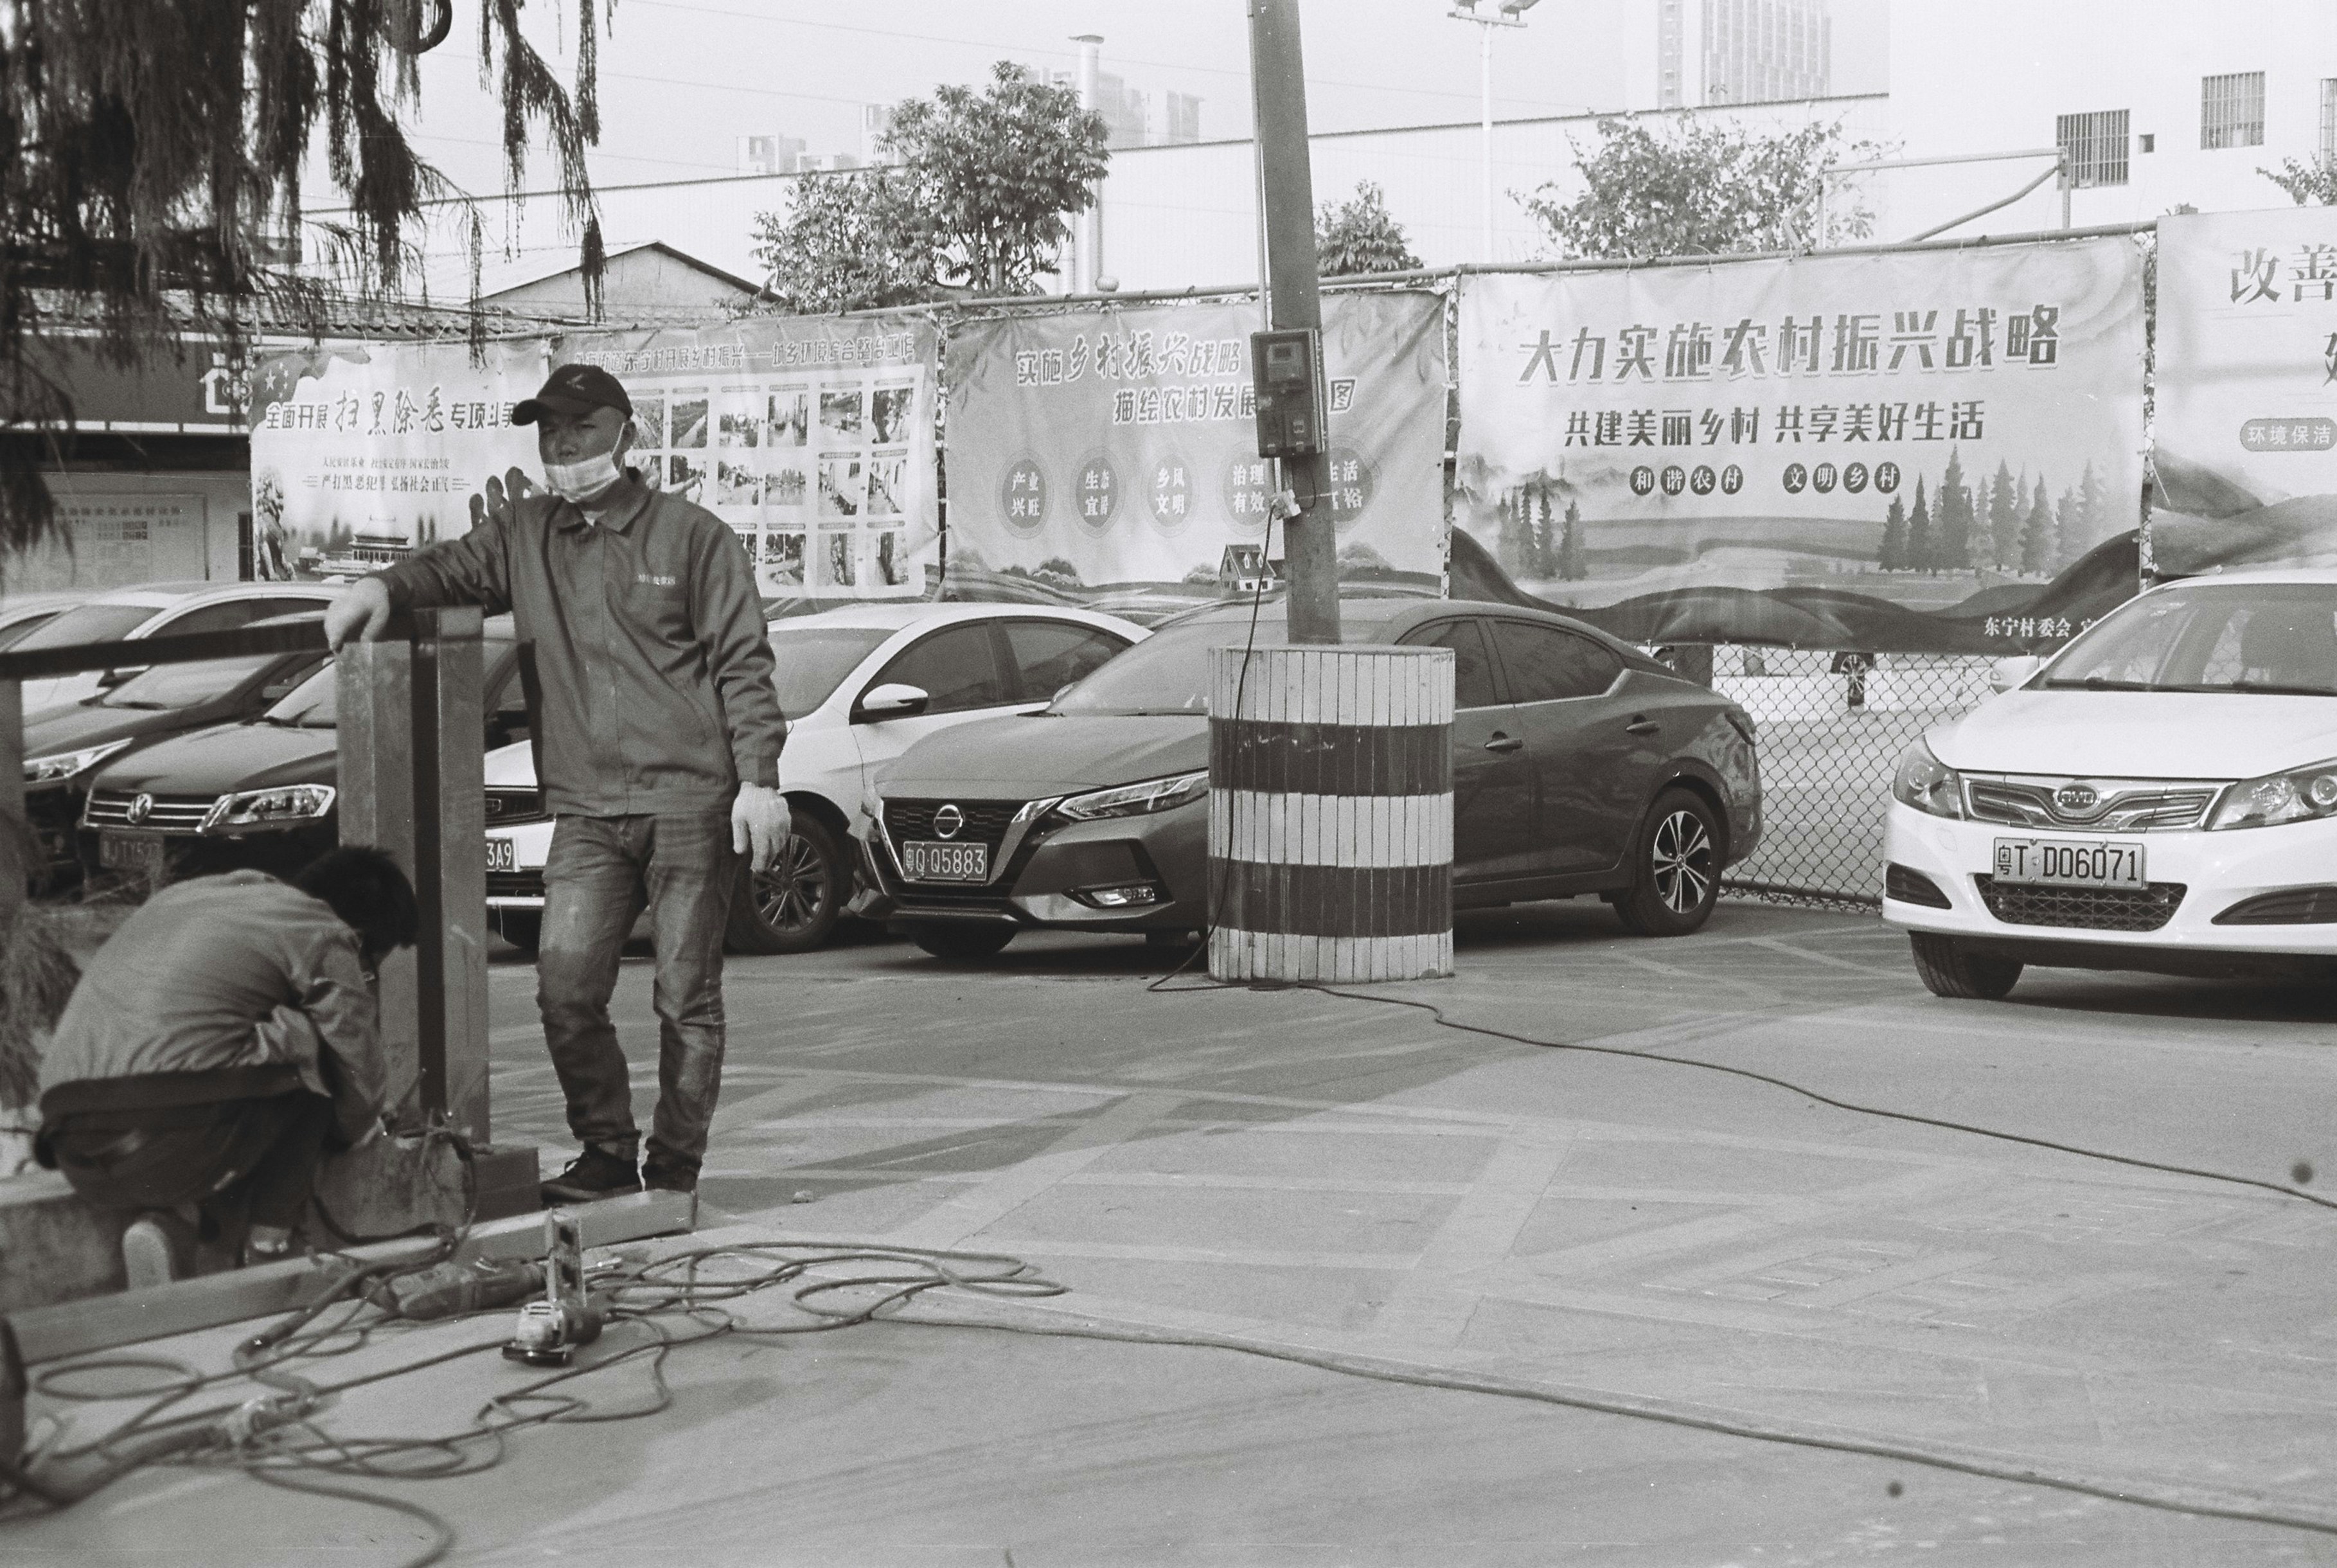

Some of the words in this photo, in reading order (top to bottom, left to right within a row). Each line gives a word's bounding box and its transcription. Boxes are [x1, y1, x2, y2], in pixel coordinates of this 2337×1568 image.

[1518, 304, 2059, 384] 大力实施农村振兴战略
[1017, 330, 1241, 384] 实施乡村振兴战略
[1565, 406, 1759, 447] 共建美丽乡村
[1775, 400, 1985, 443] 共享美好生活
[2247, 424, 2331, 445] 环境保洁
[1012, 471, 1038, 492] 产业
[1085, 469, 1109, 489] 生态
[1157, 467, 1184, 488] 乡风
[1233, 464, 1265, 486] 治理
[1634, 465, 1741, 493] 和谐农村
[1787, 465, 1896, 490] 文明乡村
[1011, 497, 1040, 517] 兴旺
[1085, 495, 1109, 515] 宜居
[1156, 494, 1184, 515] 文明
[1233, 492, 1265, 513] 有效
[1984, 616, 2071, 637] 东宁村委会
